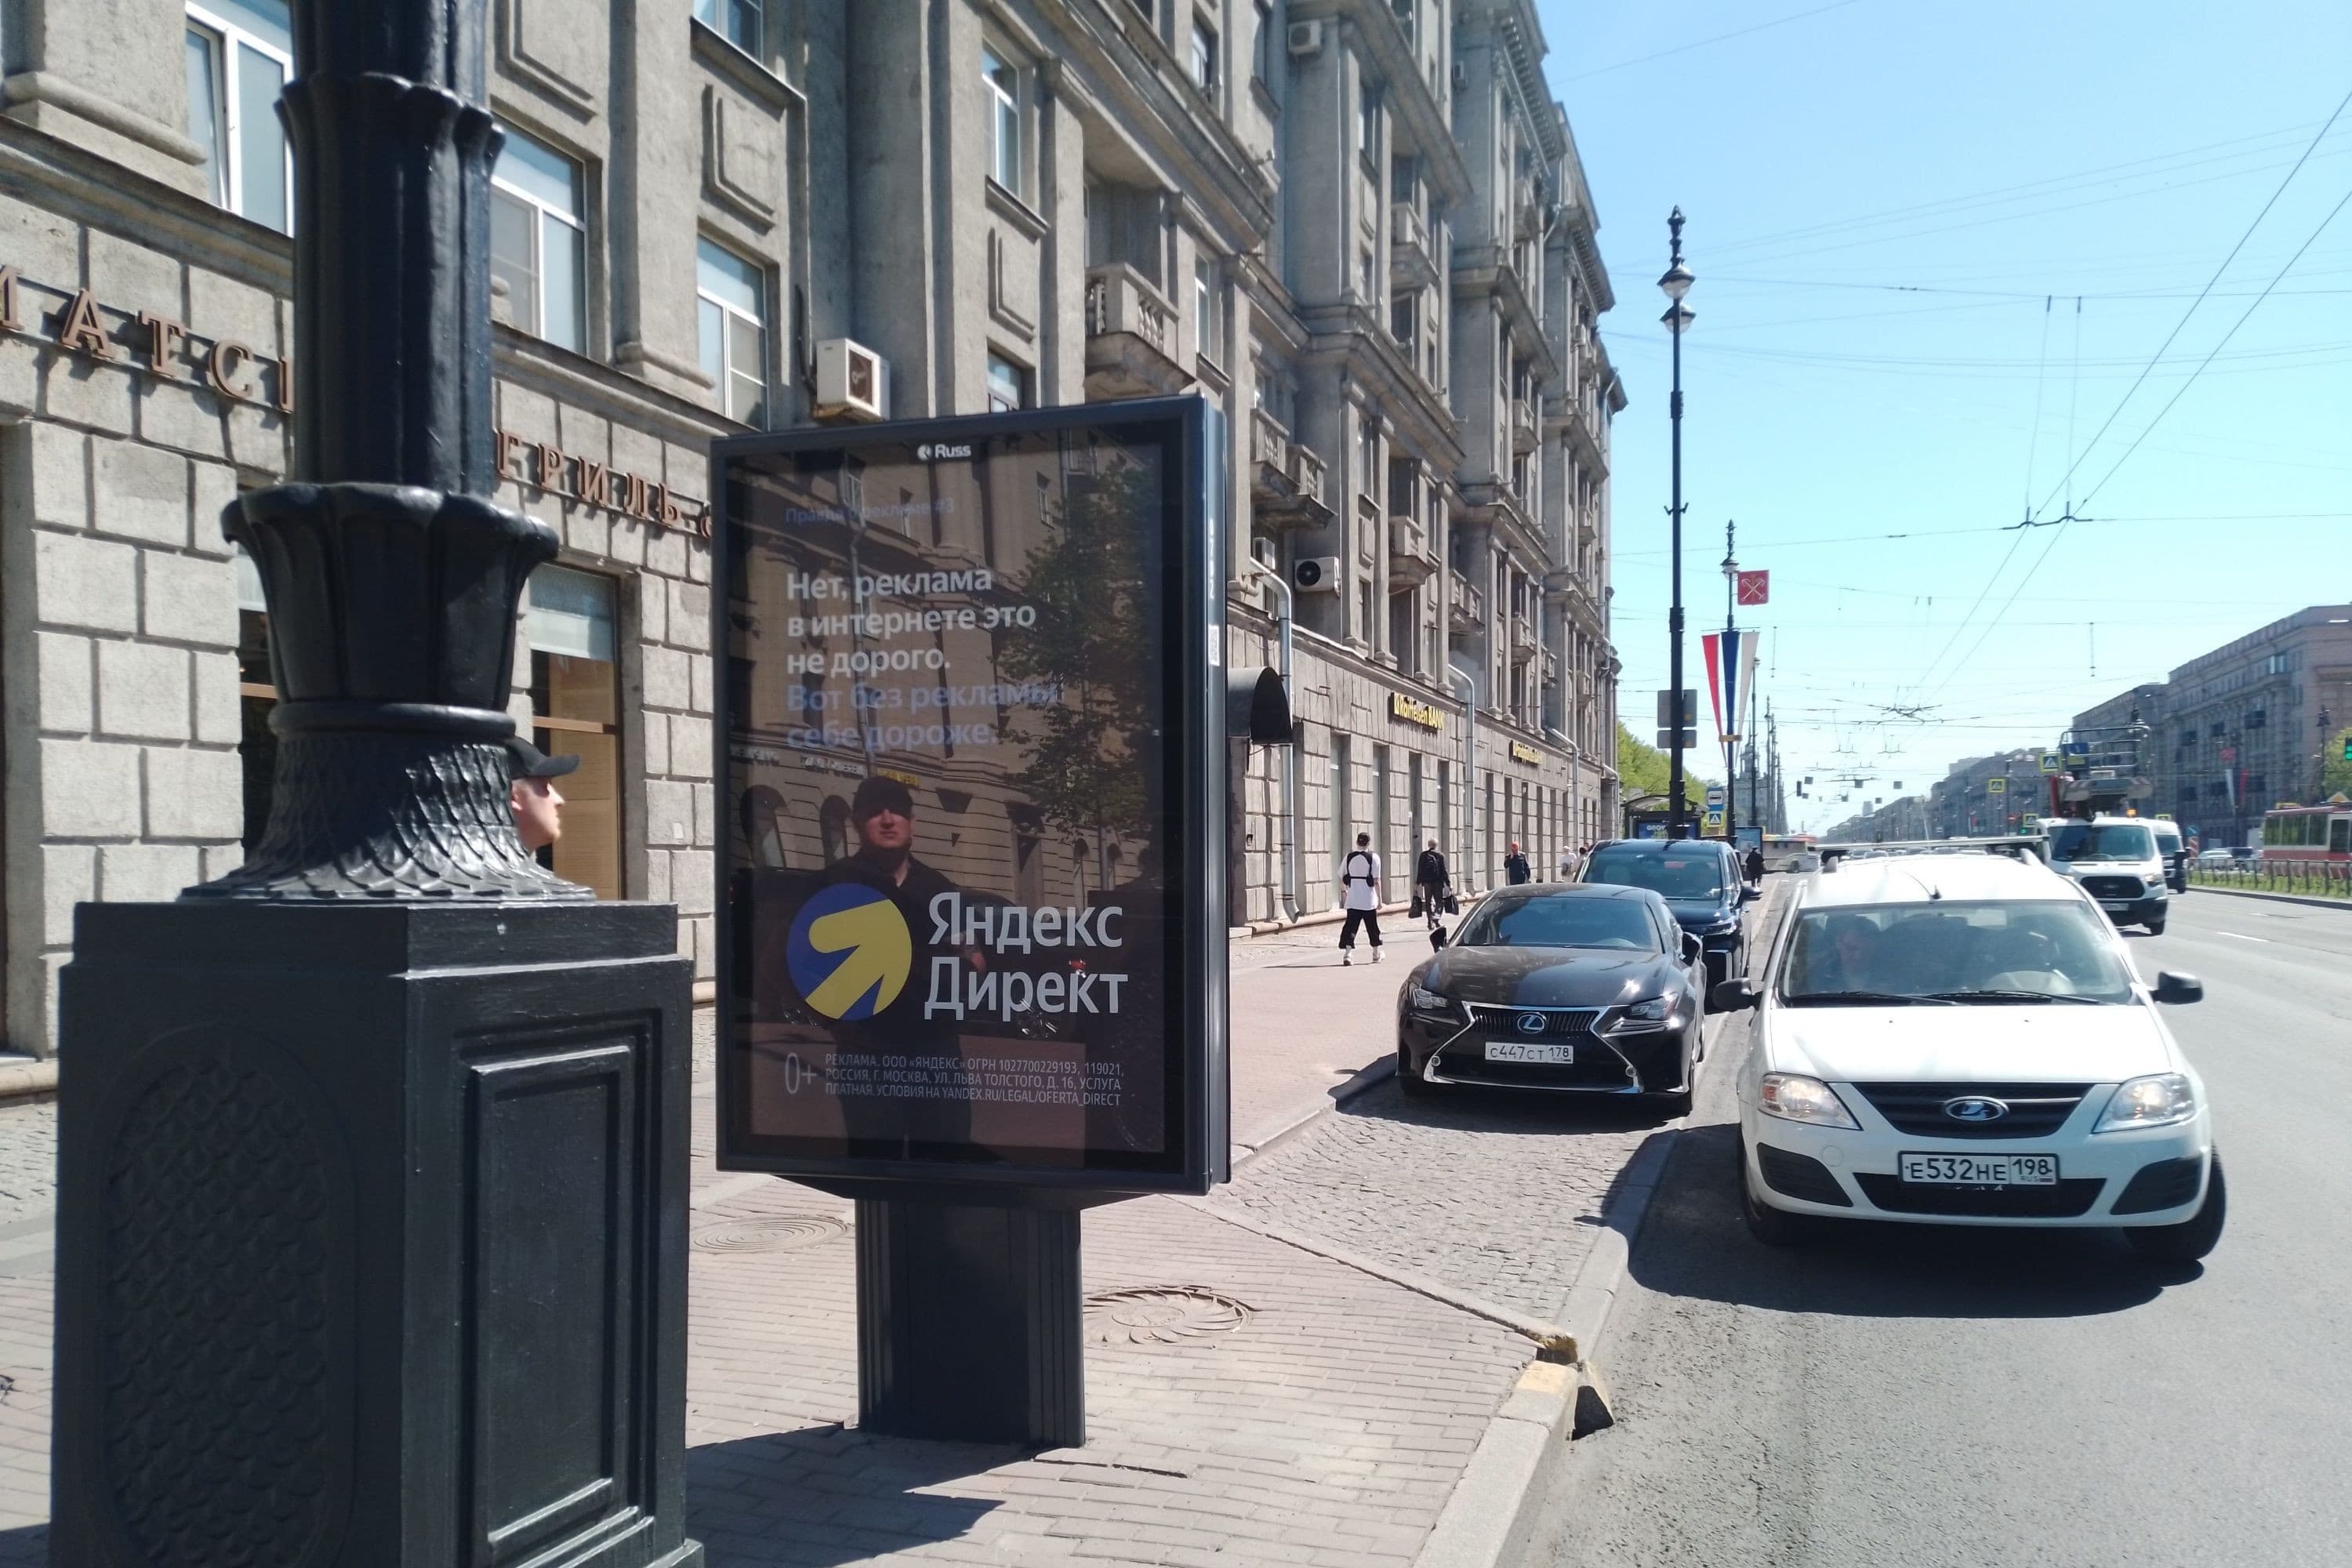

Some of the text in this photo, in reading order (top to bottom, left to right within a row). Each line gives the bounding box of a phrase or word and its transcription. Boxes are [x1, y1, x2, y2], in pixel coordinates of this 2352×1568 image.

[935, 444, 971, 458] Russ
[787, 570, 992, 602] Нет, реклама
[788, 604, 1036, 639] в интернете это
[788, 648, 951, 678] не дорого.
[788, 684, 843, 711] Вот
[850, 680, 903, 708] без
[1400, 694, 1444, 730] Raiffeisen BANK
[787, 721, 997, 753] себе дороже.
[928, 891, 1123, 954] Яндекс
[924, 956, 1128, 1022] Директ
[826, 1053, 880, 1067] РЕКЛАМА.
[882, 1055, 906, 1067] ООО
[967, 1058, 996, 1071] ОГРН
[999, 1059, 1080, 1076] 1027700229193,
[1084, 1062, 1124, 1077] 119021,
[1549, 1047, 1569, 1058] 178
[785, 1052, 817, 1094] 0+
[826, 1068, 871, 1082] РОССИЯ,
[934, 1072, 951, 1083] УЛ.
[953, 1073, 982, 1085] ЛЬВА
[1080, 1077, 1121, 1091] УСЛУГА
[877, 1085, 924, 1097] УСЛОВИЯ
[926, 1087, 940, 1098] НА
[1911, 1157, 2049, 1181] Е532НЕ 198
